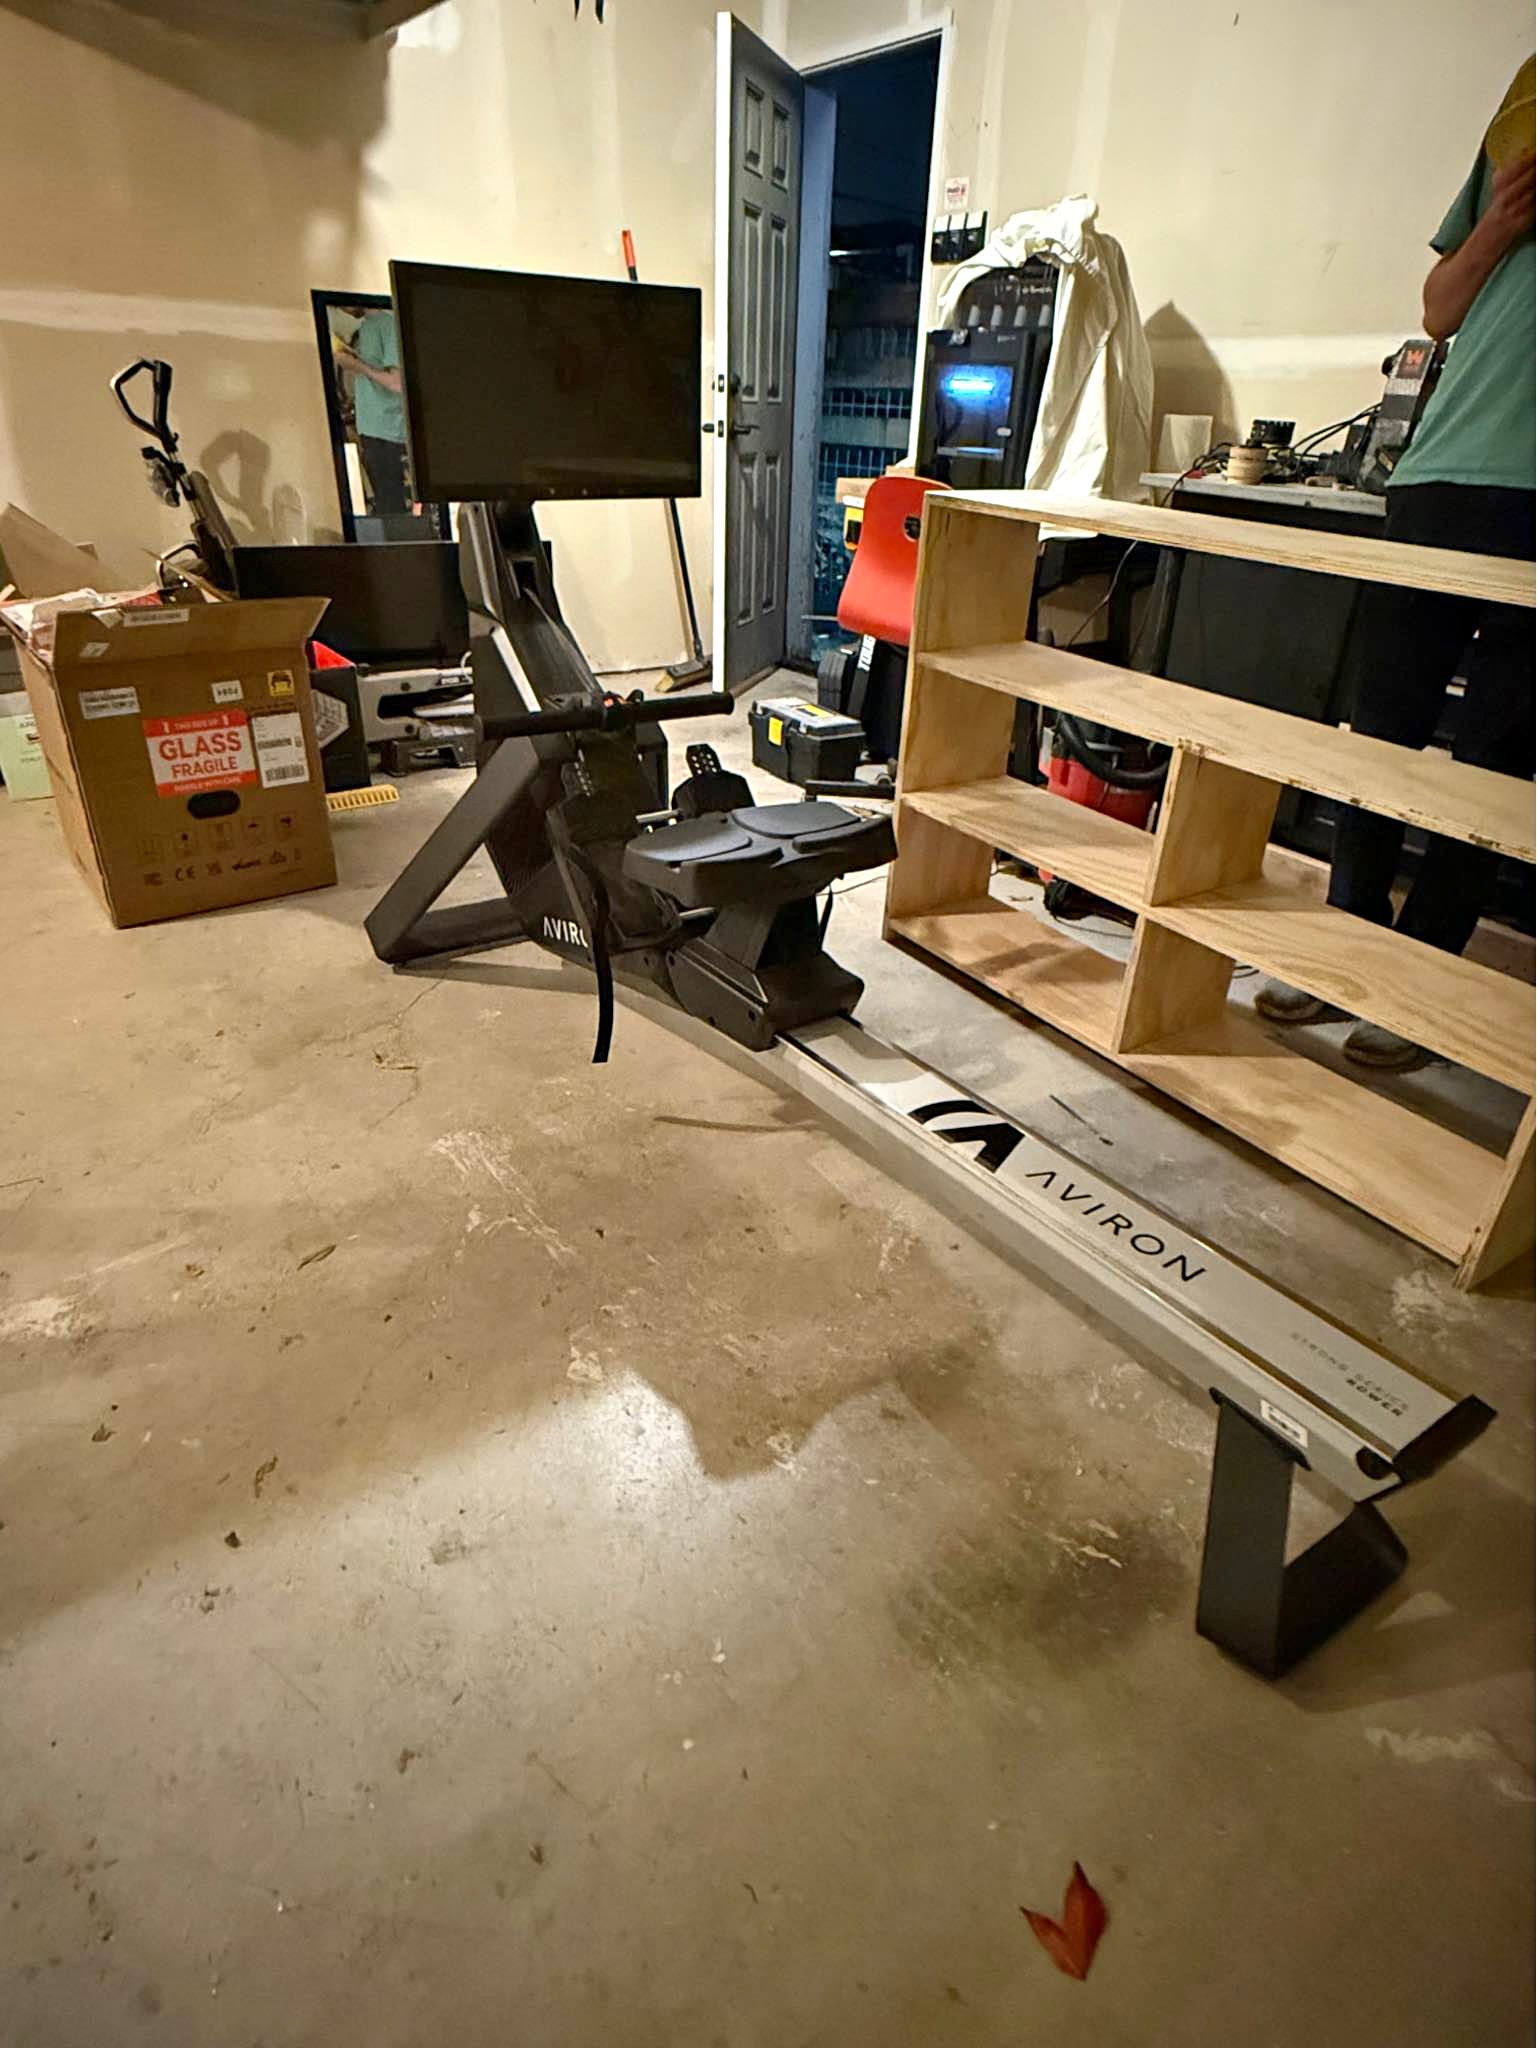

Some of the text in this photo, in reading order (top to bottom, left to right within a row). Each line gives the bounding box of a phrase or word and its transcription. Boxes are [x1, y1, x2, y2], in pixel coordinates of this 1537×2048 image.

[159, 731, 242, 761] GLASS
[171, 756, 238, 779] FRAGILE
[1025, 1171, 1206, 1282] AVIRON
